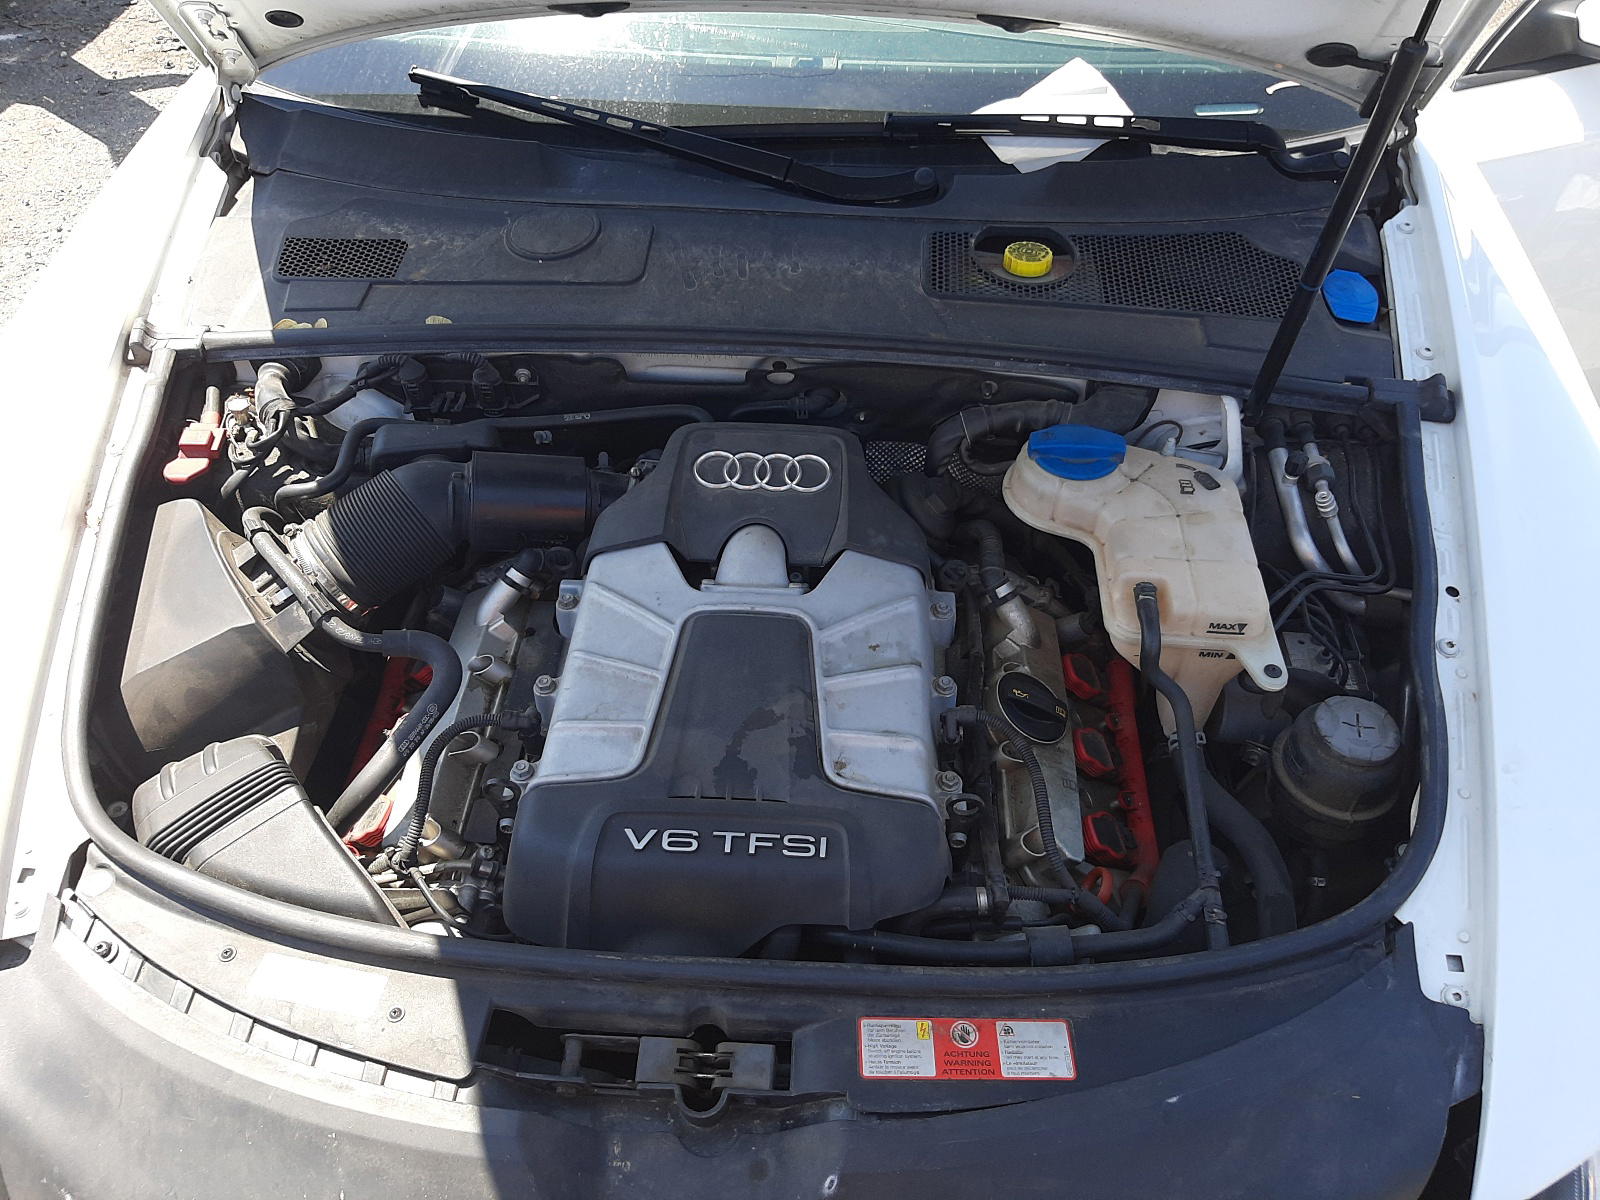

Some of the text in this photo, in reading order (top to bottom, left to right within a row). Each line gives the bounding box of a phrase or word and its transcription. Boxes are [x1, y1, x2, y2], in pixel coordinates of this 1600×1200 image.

[1208, 622, 1237, 630] MAX
[1198, 651, 1224, 659] MIN
[624, 828, 828, 858] V6 TFSI
[943, 1050, 990, 1058] ACHTUNG
[943, 1059, 992, 1067] WARNING
[942, 1068, 996, 1076] ATTENTION
